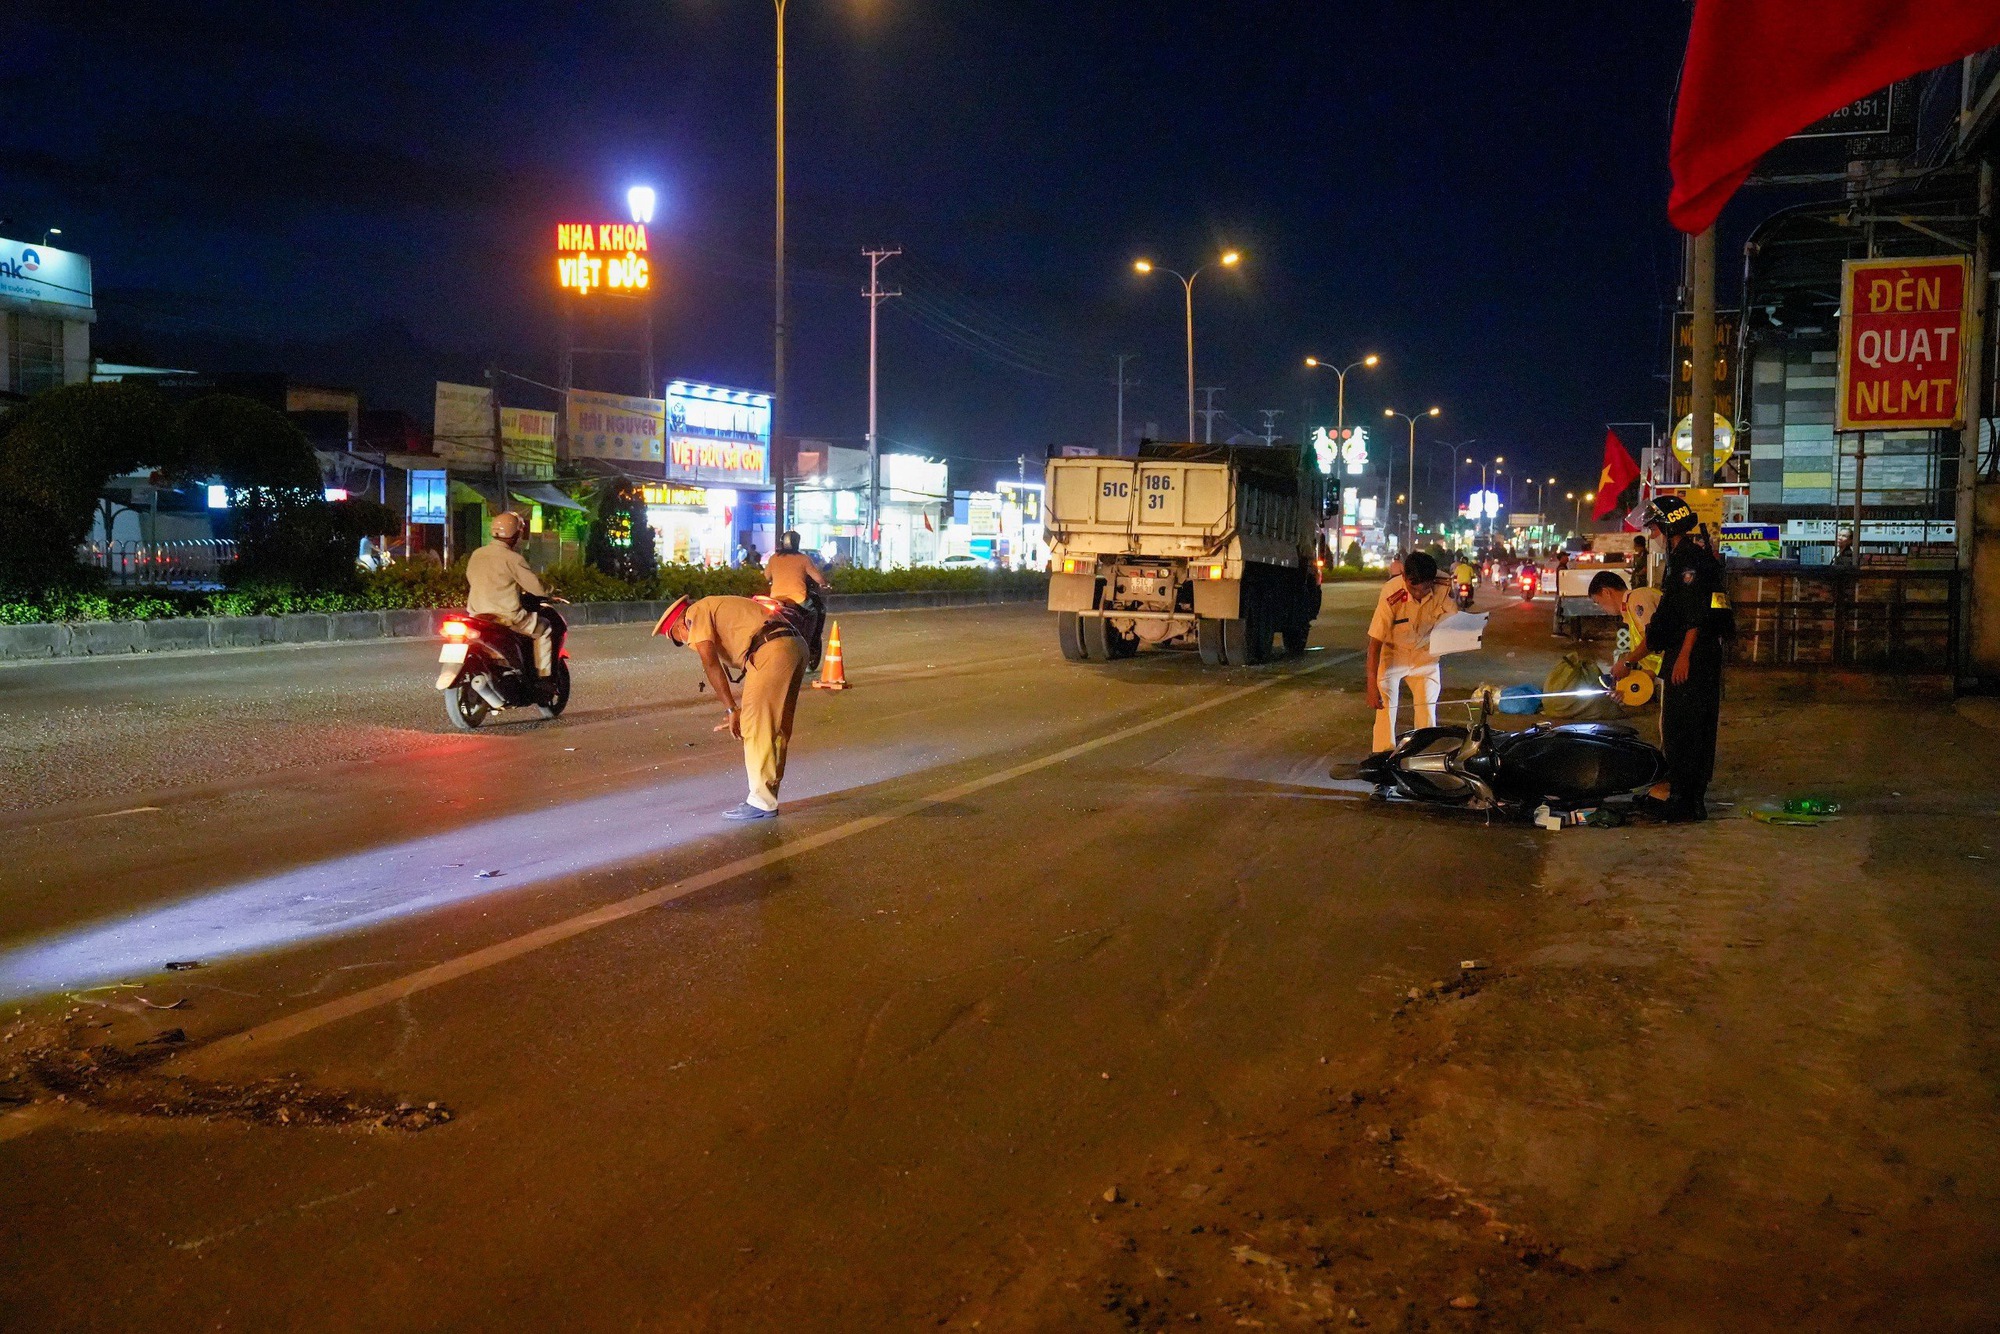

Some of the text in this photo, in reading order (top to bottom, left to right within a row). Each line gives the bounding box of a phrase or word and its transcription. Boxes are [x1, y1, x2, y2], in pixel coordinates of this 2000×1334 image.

[1854, 99, 1878, 116] 351
[558, 224, 647, 251] NHA KHOA
[558, 251, 602, 295] VIỆT
[1868, 270, 1941, 313] ĐÈN
[1858, 327, 1956, 371] QUẠT
[1856, 378, 1952, 415] NLMT
[671, 438, 695, 472] VIỆT
[1103, 482, 1128, 498] 51C
[1148, 494, 1164, 509] 31
[1720, 532, 1763, 540] MAXILITE
